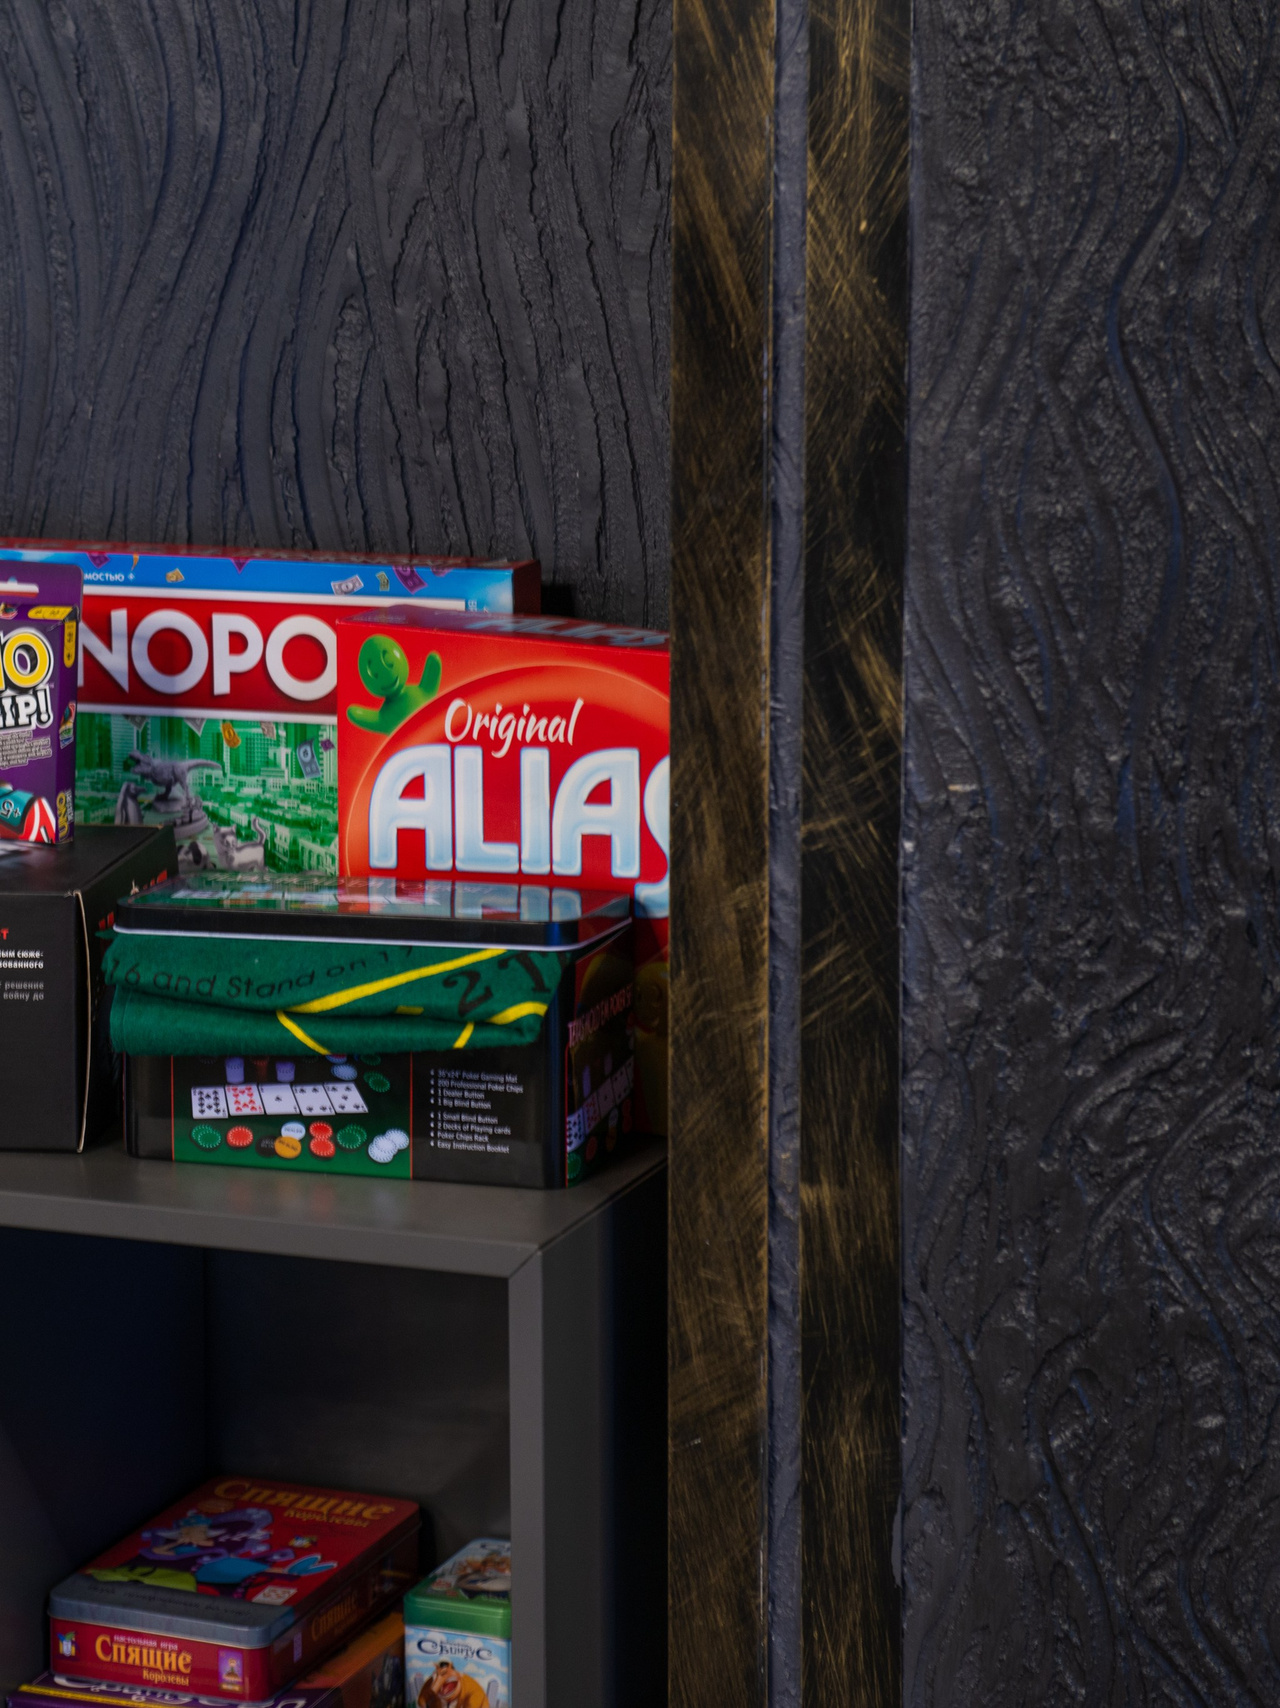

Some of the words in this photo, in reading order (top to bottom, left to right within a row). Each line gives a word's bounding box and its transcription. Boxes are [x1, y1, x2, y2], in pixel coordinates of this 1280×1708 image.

[444, 697, 585, 759] Original
[56, 791, 70, 842] UNO
[5, 980, 44, 990] решение
[110, 959, 141, 986] 16
[153, 972, 217, 997] and
[227, 969, 315, 999] Stand
[326, 959, 367, 978] on
[3, 991, 30, 1001] войну
[33, 992, 44, 1001] до
[442, 970, 493, 1018] 2
[462, 1070, 479, 1080] Poker
[480, 1072, 504, 1083] Gaming
[505, 1073, 518, 1083] Mat
[438, 1079, 449, 1087] 200
[450, 1080, 486, 1090] Professional
[487, 1083, 505, 1092] Poker
[506, 1083, 523, 1094] Chips
[443, 1089, 463, 1098] Dealer
[464, 1090, 485, 1099] Button
[443, 1098, 453, 1108] Big
[454, 1099, 470, 1108] Blind
[470, 1100, 491, 1110] Button
[442, 1112, 460, 1121] Small
[461, 1113, 477, 1122] Blind
[477, 1114, 498, 1124] Button
[443, 1122, 461, 1131] Decks
[462, 1123, 469, 1131] of
[470, 1124, 493, 1134] Playing
[494, 1126, 511, 1135] cards
[438, 1131, 454, 1140] Poker
[456, 1132, 473, 1142] Chips
[474, 1133, 489, 1143] Rack
[438, 1140, 451, 1150] Easy
[453, 1141, 485, 1152] Instruction
[486, 1143, 509, 1154] Booklet
[214, 1479, 396, 1520] Спящие
[114, 1634, 157, 1648] настольная
[160, 1642, 178, 1652] игра
[95, 1634, 193, 1674] Спящие
[142, 1669, 189, 1687] Королевы
